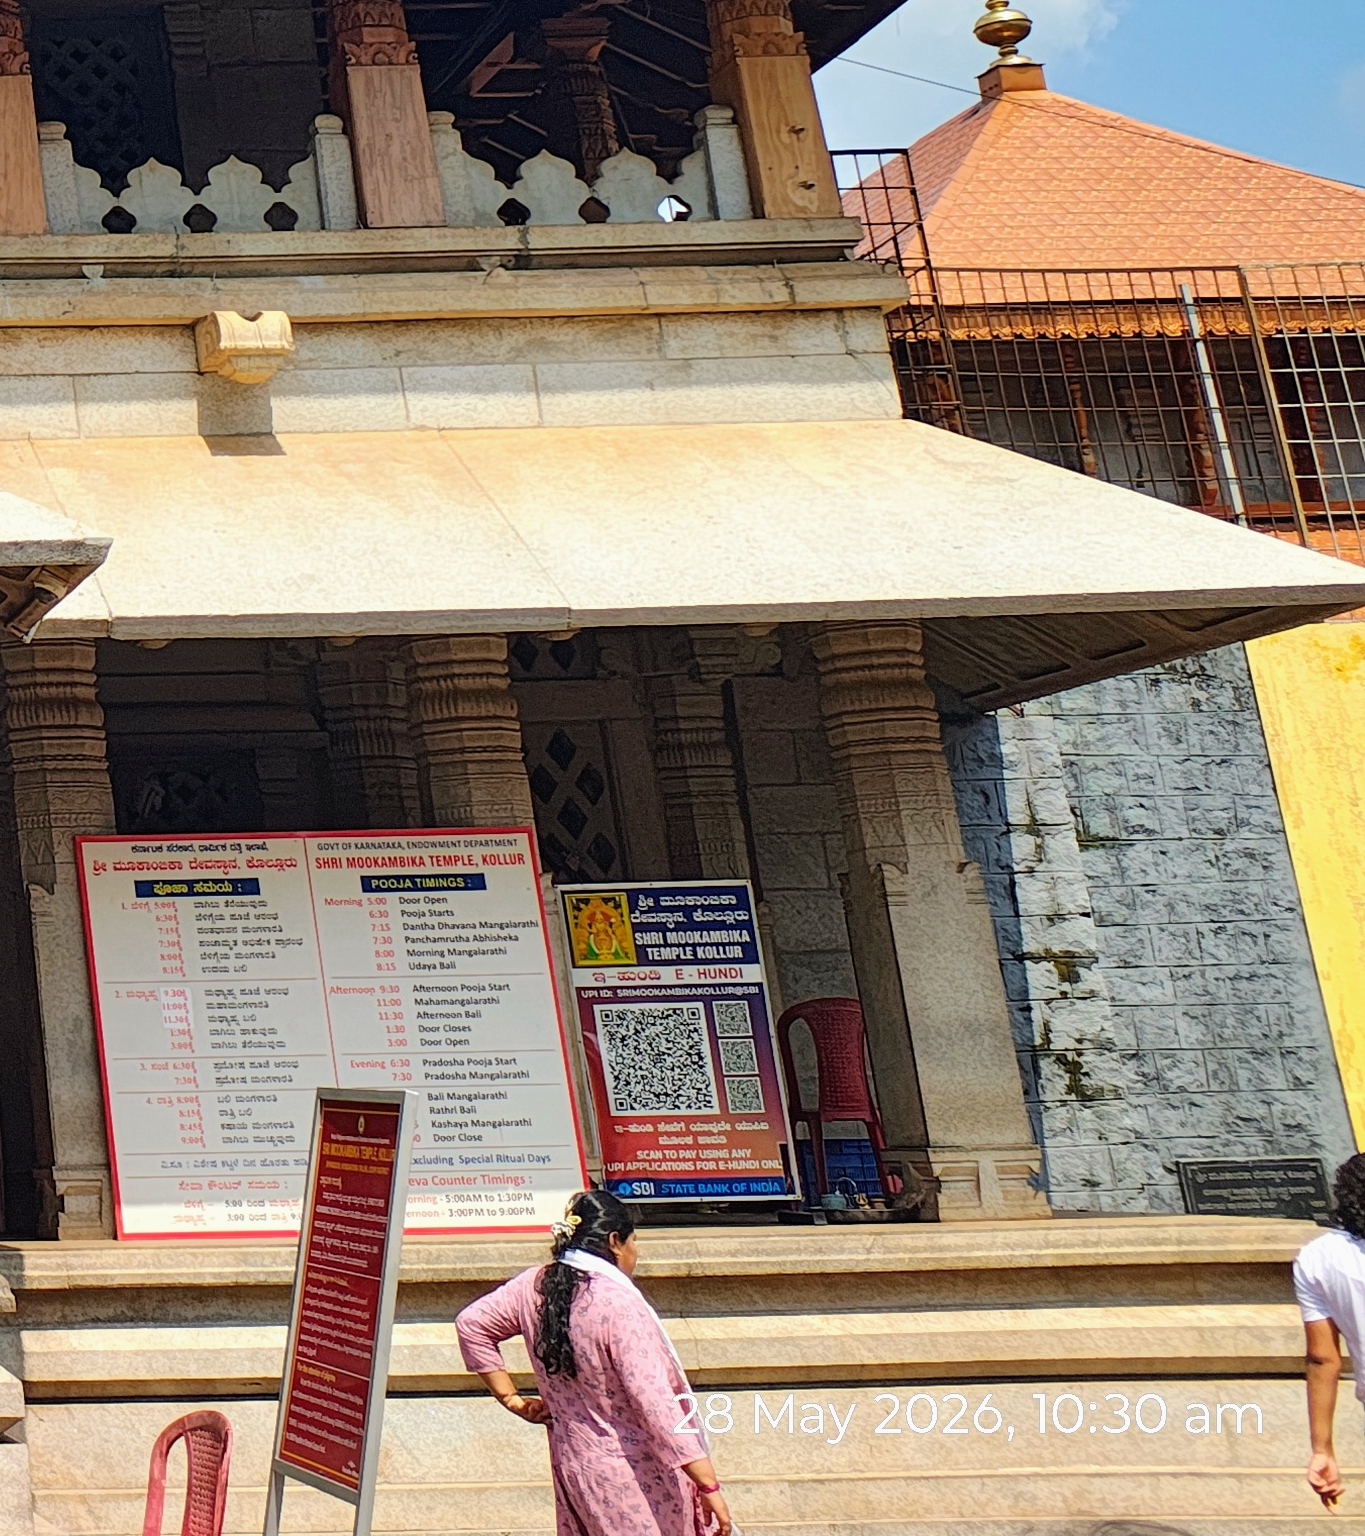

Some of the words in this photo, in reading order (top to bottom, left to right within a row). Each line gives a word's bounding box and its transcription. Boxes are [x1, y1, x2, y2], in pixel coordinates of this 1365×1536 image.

[317, 842, 340, 851] GOVT
[341, 842, 352, 850] OF
[354, 841, 405, 850] KARNATAKA,
[463, 839, 517, 848] DEPARTMENT
[93, 859, 107, 875] ಶ್ರೀ
[315, 857, 342, 869] SHRI
[346, 856, 426, 869] MOOKAMBIKA
[428, 854, 479, 868] TEMPLE,
[481, 853, 525, 866] KOLLUR
[371, 878, 413, 889] POOJA
[415, 878, 465, 888] TIMINGS
[398, 896, 422, 905] Door
[424, 896, 448, 907] Open
[637, 894, 655, 911] ಶ್ರೀ
[368, 910, 389, 918] 6:30
[400, 909, 426, 919] Pooja
[428, 909, 455, 918] Starts
[373, 936, 393, 945] 7:30
[634, 932, 664, 945] SHRI
[666, 929, 751, 944] MOOKAMBIKA
[646, 946, 695, 961] TEMPLE
[696, 945, 744, 959] KOLLUR
[674, 968, 685, 979] E
[697, 967, 744, 979] HUNDI
[379, 985, 400, 994] 9:30
[412, 984, 459, 993] Afternoon
[460, 983, 486, 995] Pooja
[487, 983, 511, 992] Start
[581, 988, 598, 998] UPI
[376, 998, 402, 1007] 11:00
[390, 1059, 410, 1068] 6:30
[422, 1057, 465, 1067] Pradosha
[467, 1057, 493, 1068] Pooja
[494, 1057, 517, 1066] Start
[391, 1072, 413, 1081] 7:30
[424, 1071, 467, 1081] Pradosha
[433, 1133, 456, 1142] Door
[458, 1133, 483, 1142] Close
[410, 1154, 454, 1166] xcluding
[458, 1154, 494, 1165] Special
[527, 1154, 552, 1165] Days
[636, 1149, 663, 1160] SCAN
[663, 1149, 677, 1159] TO
[679, 1149, 698, 1159] PAY
[699, 1149, 729, 1159] USING
[731, 1148, 752, 1158] ANY
[607, 1162, 624, 1172] UPI
[625, 1161, 695, 1171] APPLICATIONS
[696, 1160, 715, 1170] FOR
[408, 1176, 429, 1186] eva
[431, 1175, 478, 1186] Counter
[480, 1174, 526, 1186] Timings
[632, 1182, 655, 1196] SBI
[661, 1183, 696, 1195] STATE
[699, 1182, 730, 1194] BANK
[734, 1183, 747, 1193] OF
[407, 1194, 438, 1205] orning
[445, 1194, 482, 1204] 5:00AM
[484, 1193, 495, 1202] to
[497, 1192, 533, 1202] 1:30PM
[448, 1208, 485, 1217] 3:00PM
[487, 1207, 497, 1216] to
